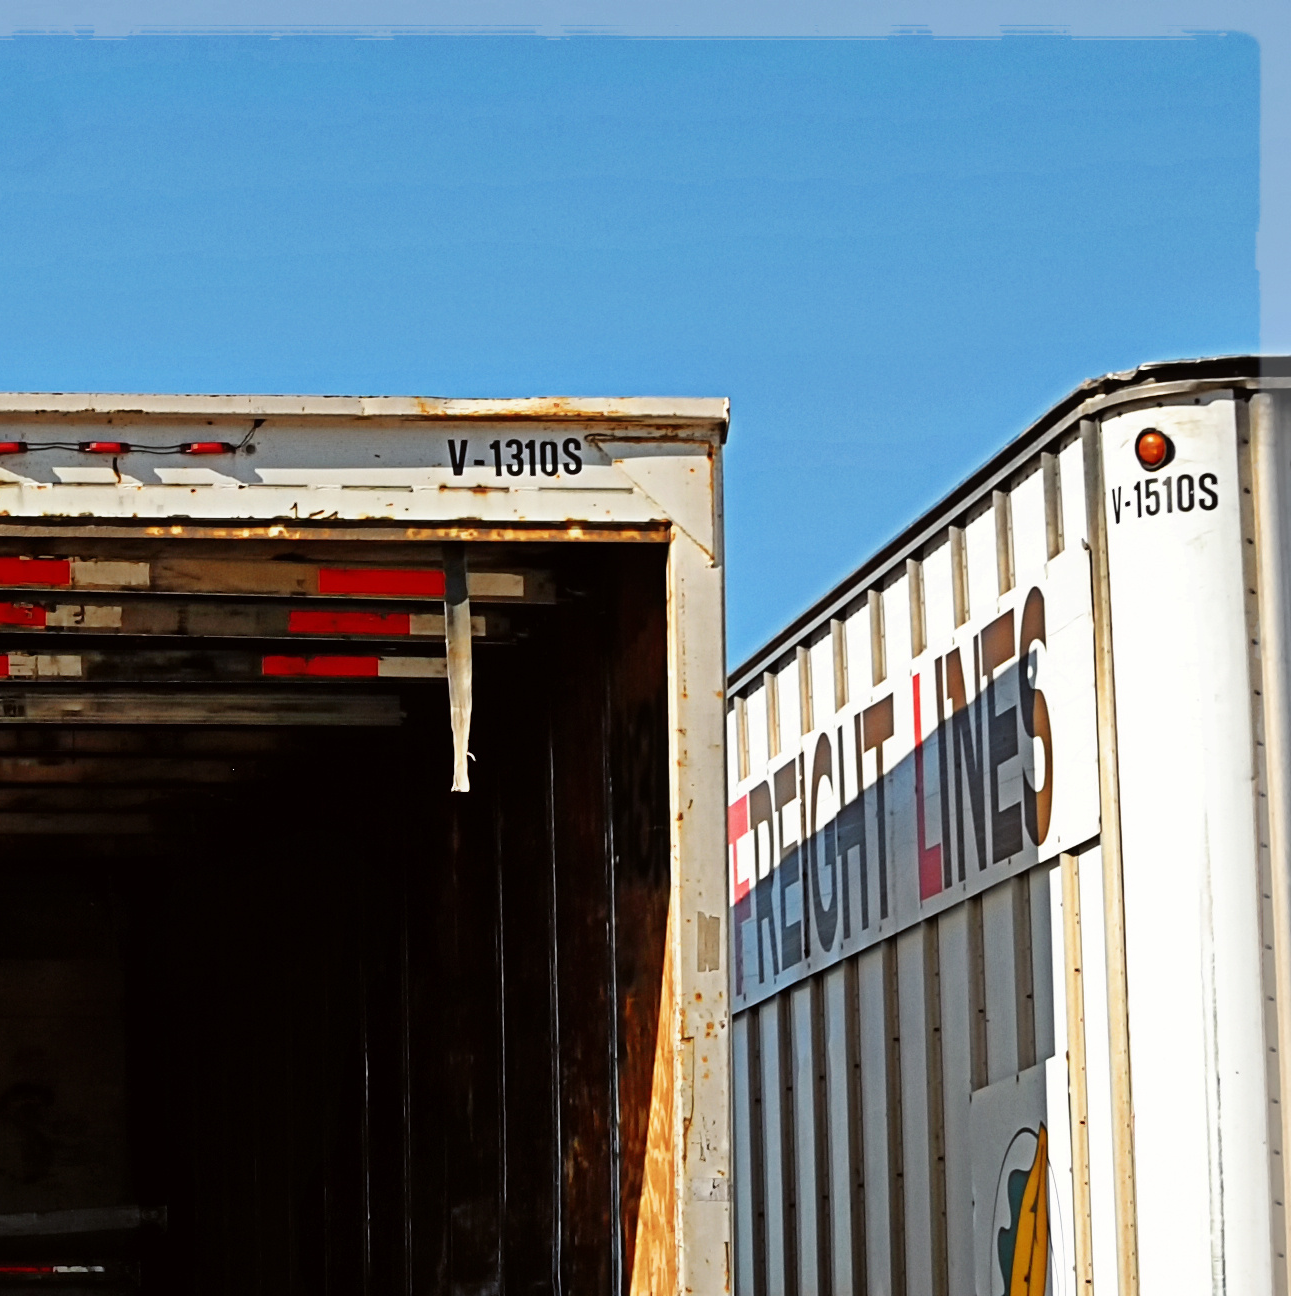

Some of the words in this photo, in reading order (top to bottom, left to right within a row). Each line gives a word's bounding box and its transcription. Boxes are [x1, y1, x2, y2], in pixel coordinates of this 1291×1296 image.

[447, 438, 583, 478] V-1310S
[1111, 473, 1219, 525] V-1510S
[728, 692, 894, 997] FREIGHT
[911, 586, 1054, 903] LINES
